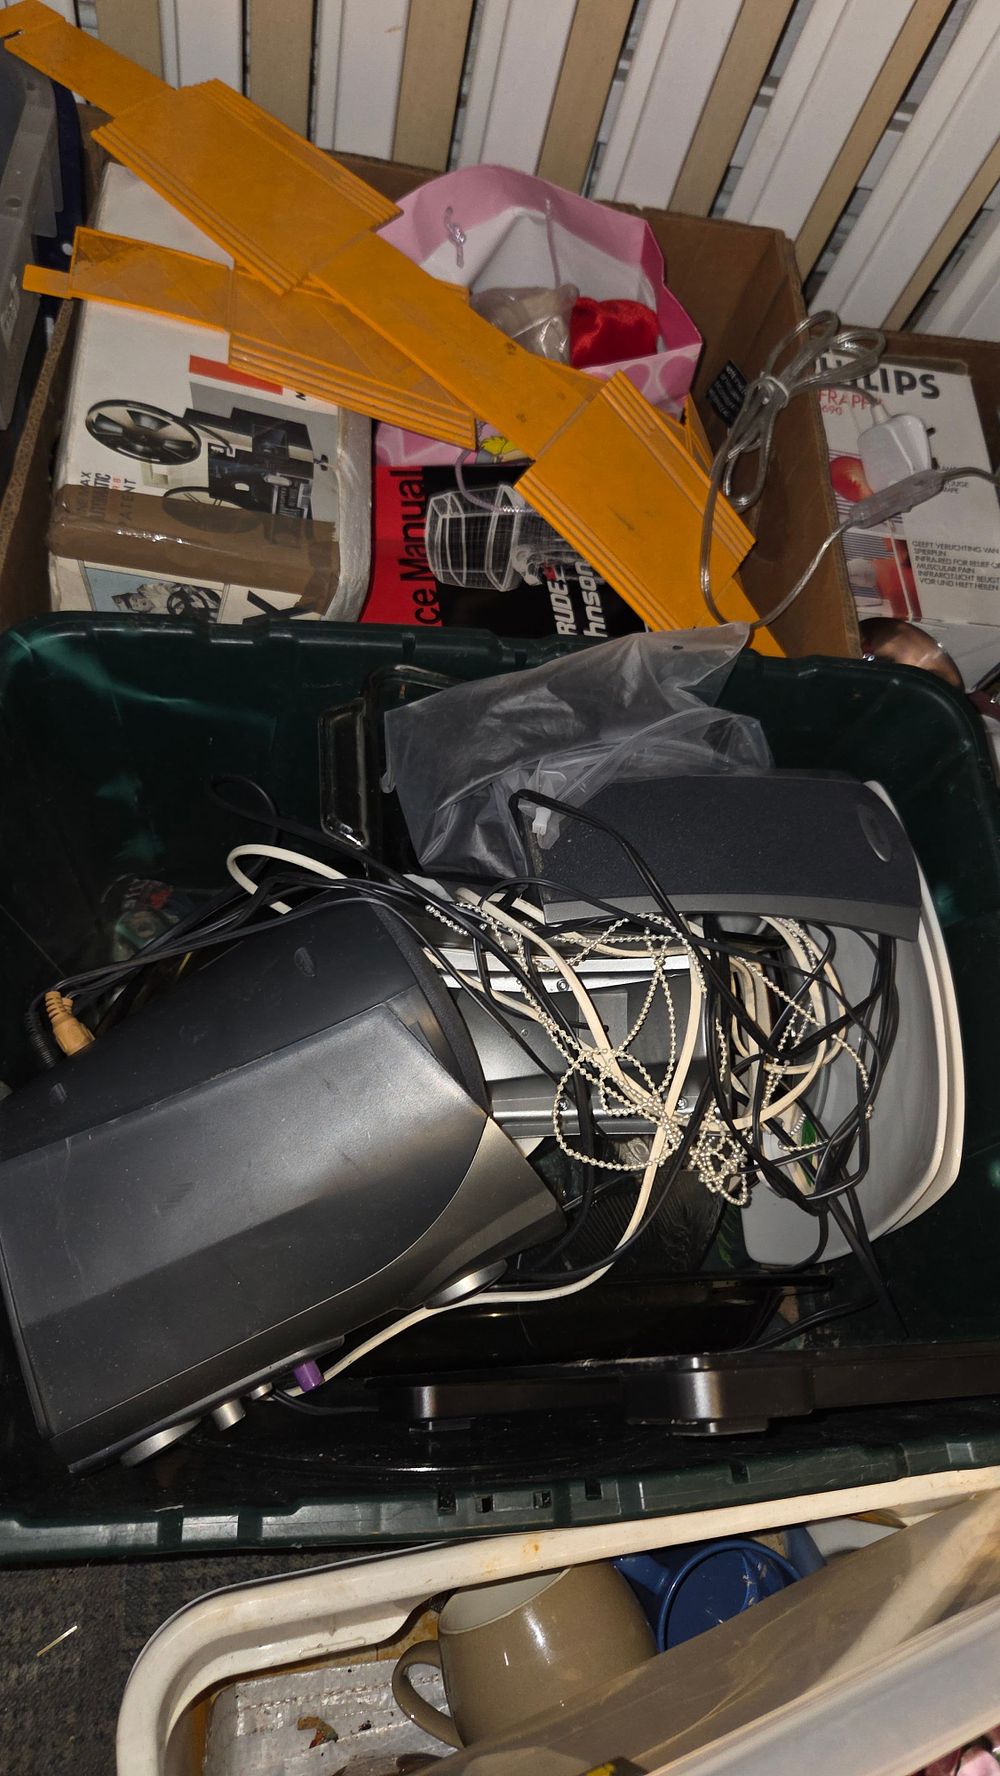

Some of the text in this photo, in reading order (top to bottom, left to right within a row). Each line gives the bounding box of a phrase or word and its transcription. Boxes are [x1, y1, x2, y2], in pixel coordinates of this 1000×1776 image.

[390, 470, 441, 625] ce Manual
[953, 558, 968, 566] FOR
[916, 563, 975, 574] MUSCULAR PAIN
[919, 577, 936, 585] VOR
[936, 579, 954, 587] UND
[547, 580, 577, 636] RUDE
[575, 561, 608, 637] hnson
